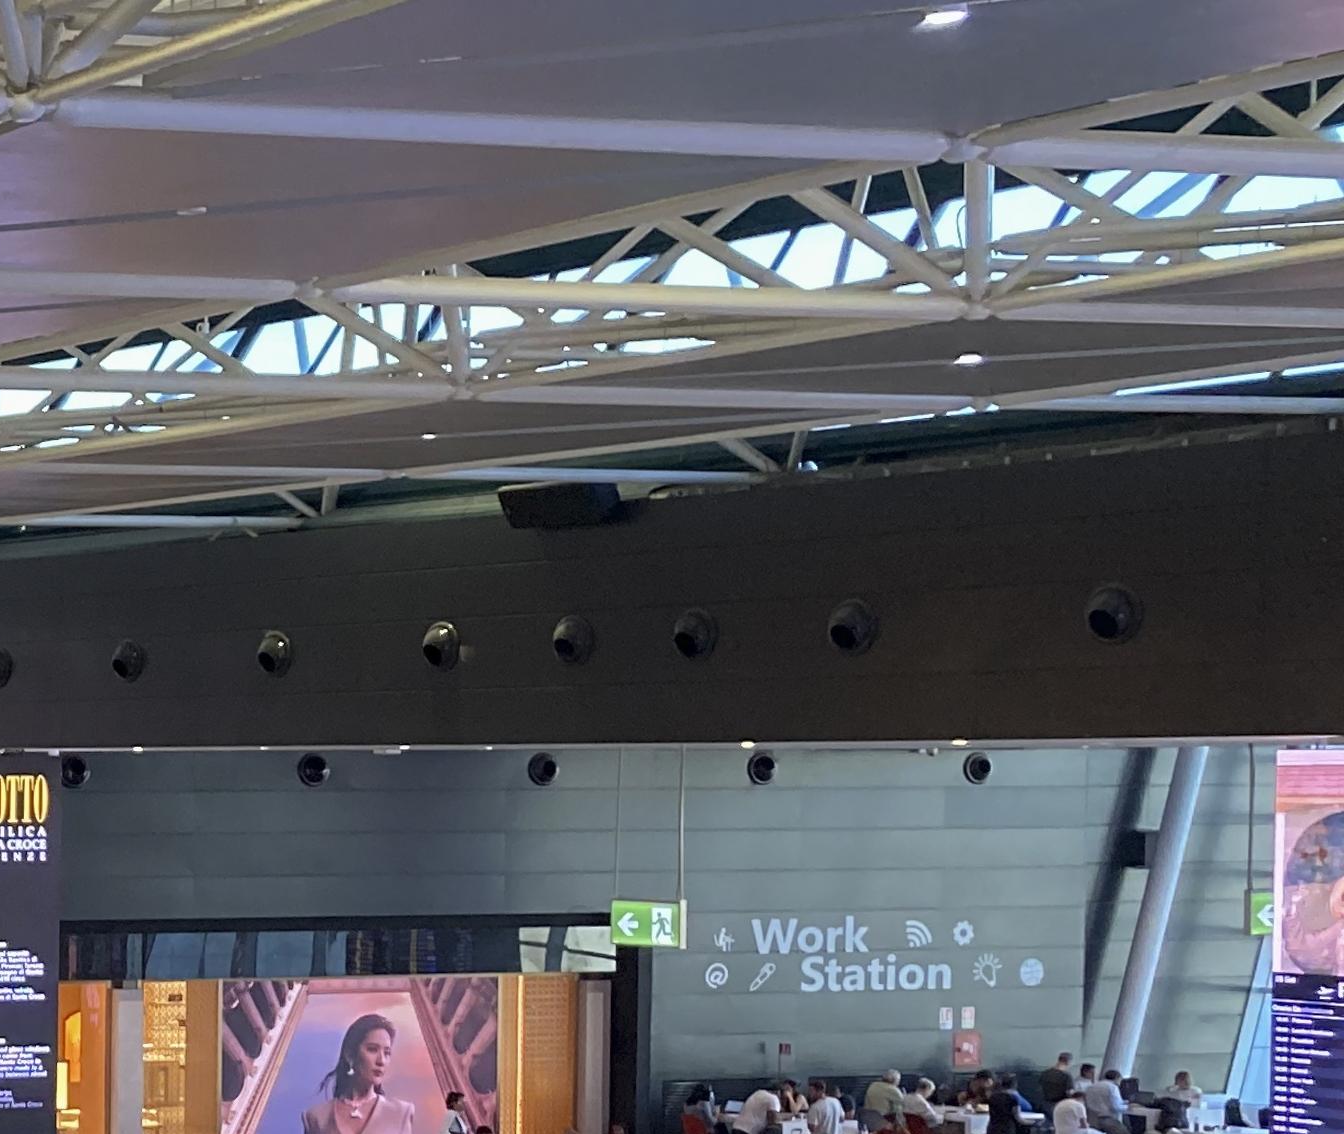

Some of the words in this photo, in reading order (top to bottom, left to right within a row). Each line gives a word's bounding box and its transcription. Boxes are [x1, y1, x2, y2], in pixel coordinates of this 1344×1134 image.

[7, 839, 47, 851] CROCE
[752, 916, 869, 955] Work
[800, 954, 951, 993] Station
